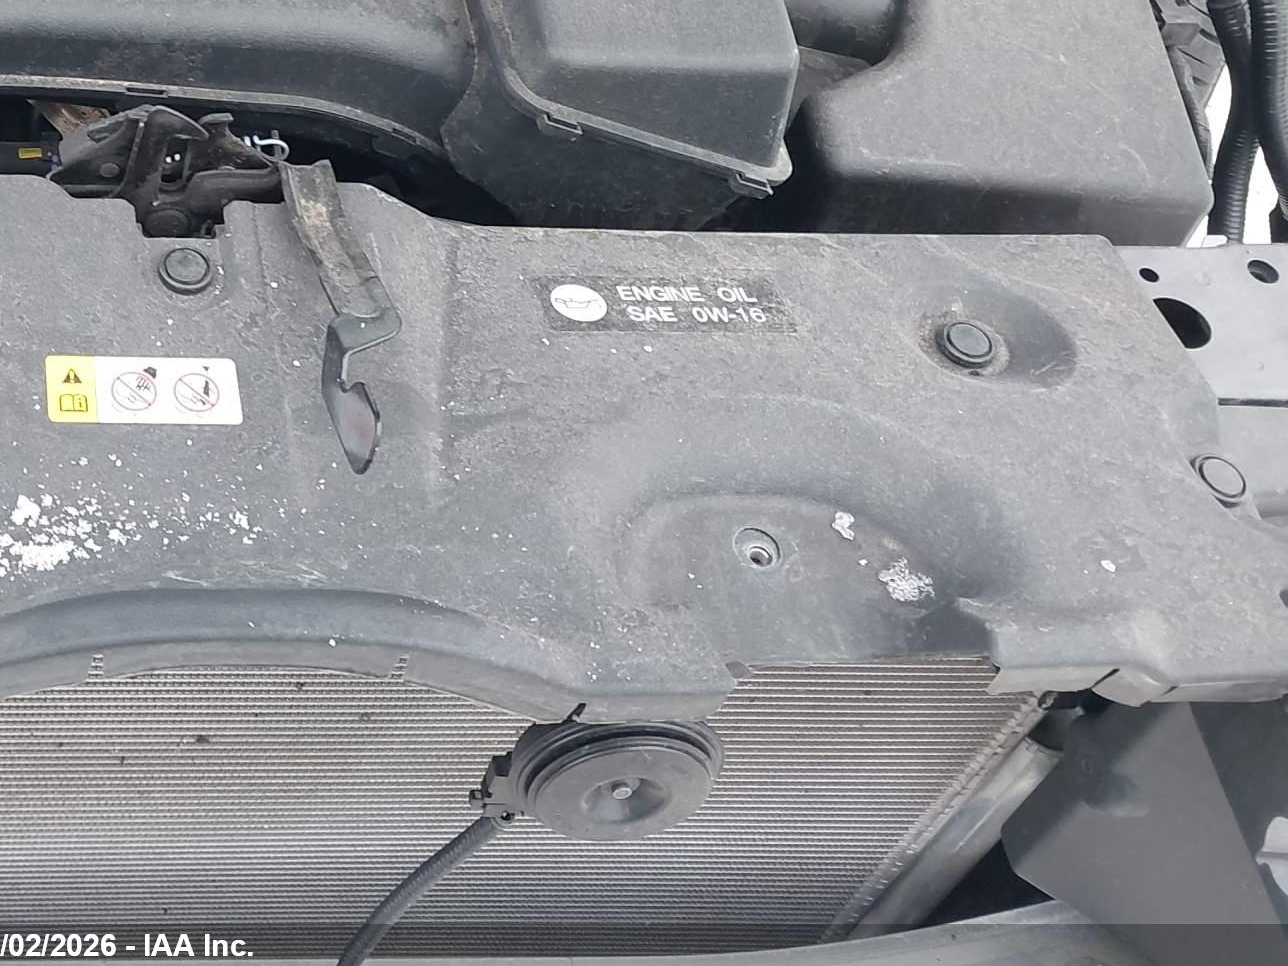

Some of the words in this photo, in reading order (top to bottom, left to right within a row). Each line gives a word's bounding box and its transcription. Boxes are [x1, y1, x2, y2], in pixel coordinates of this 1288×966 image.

[615, 285, 705, 302] ENGINE
[717, 286, 758, 303] OIL
[626, 306, 679, 322] SAE
[691, 306, 767, 323] 0W-16
